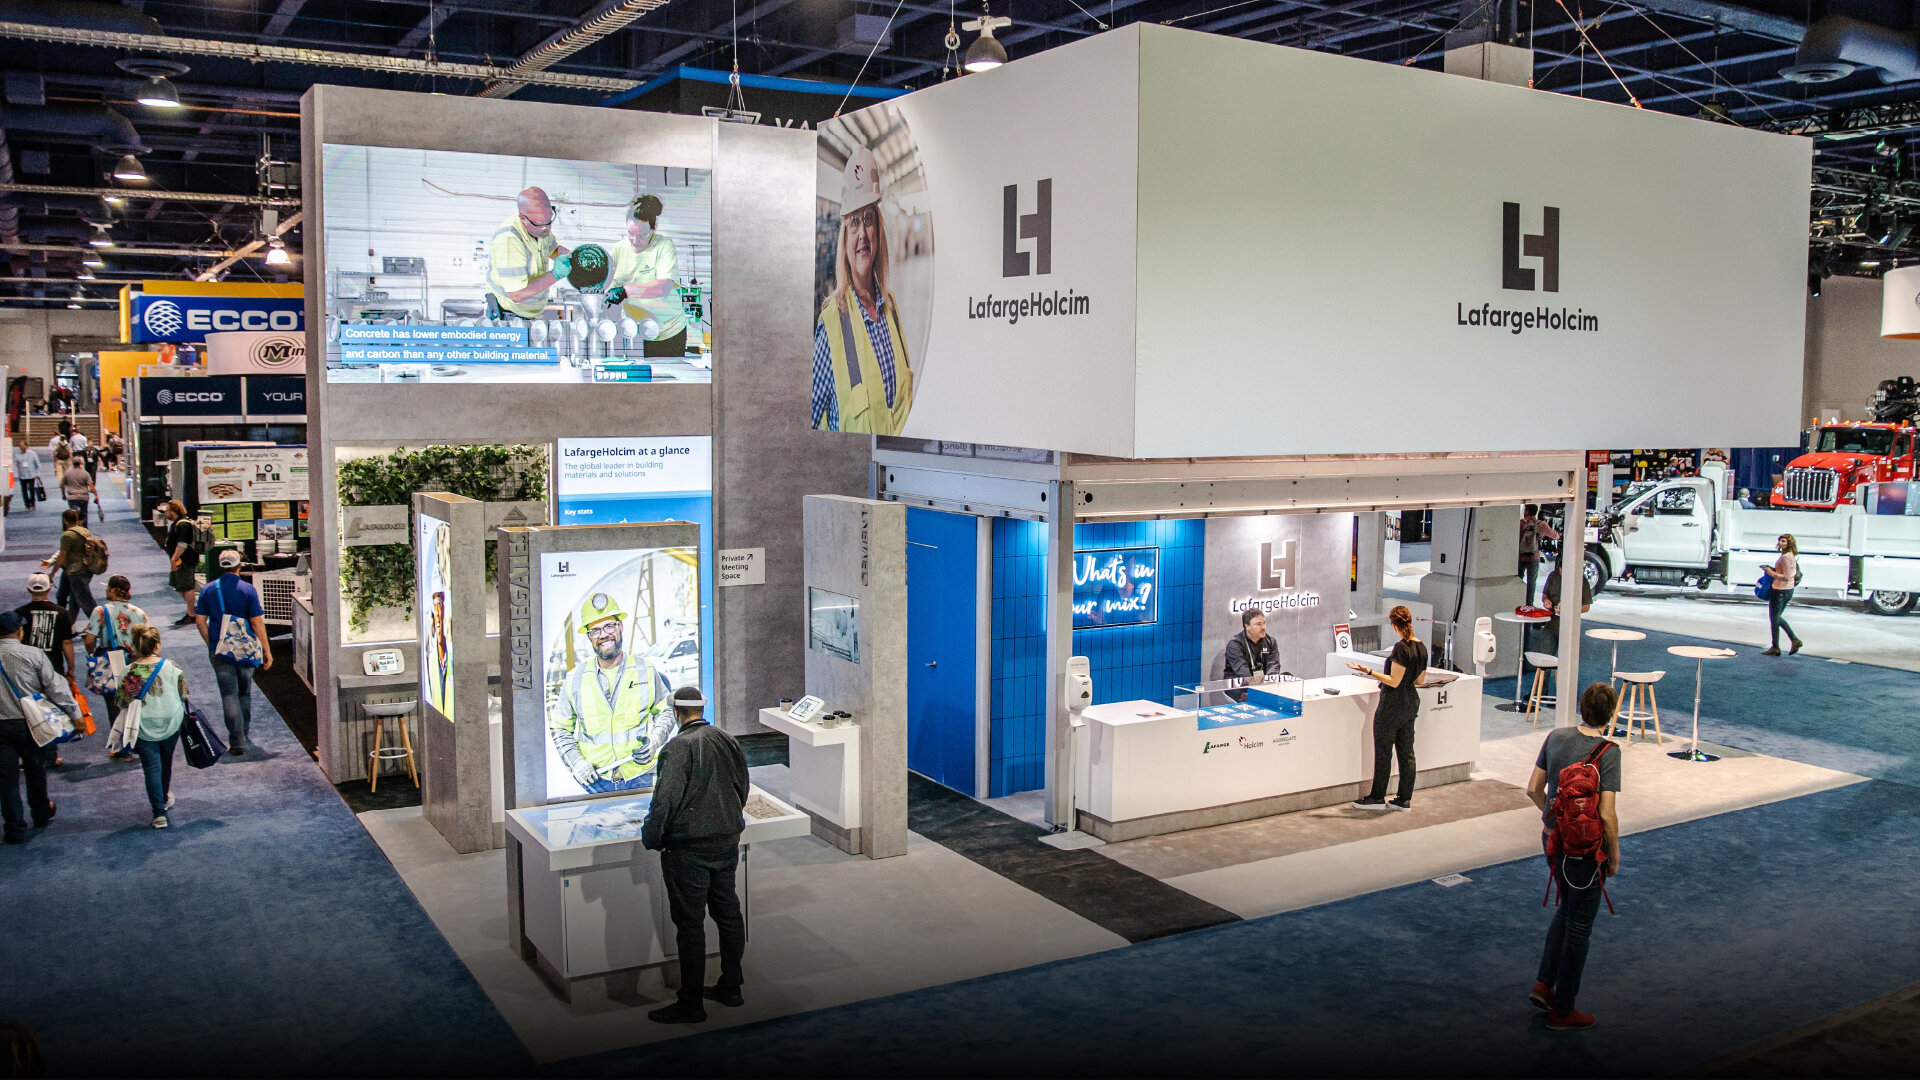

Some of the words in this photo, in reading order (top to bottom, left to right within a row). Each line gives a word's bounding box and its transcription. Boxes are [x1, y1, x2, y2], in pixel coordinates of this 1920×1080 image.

[968, 288, 1090, 325] LafargeHolcim
[186, 309, 298, 331] ECCO
[1457, 302, 1599, 335] LafargeHolcim
[345, 328, 391, 340] Concrete
[392, 329, 411, 340] has
[412, 330, 440, 341] lower
[441, 330, 487, 341] embodied
[489, 331, 521, 342] energy
[345, 349, 366, 360] and
[367, 350, 401, 360] carbon
[403, 350, 425, 360] than
[426, 351, 445, 362] any
[447, 351, 471, 361] other
[473, 351, 510, 363] building
[511, 352, 551, 362] material.
[174, 392, 223, 402] ECCO
[263, 392, 303, 401] YOUR
[564, 446, 636, 459] LafargeHolcim
[638, 447, 649, 456] at
[659, 446, 690, 457] glance
[579, 463, 602, 472] global
[635, 461, 664, 470] building
[564, 471, 598, 479] materials
[614, 470, 646, 478] solutions
[564, 508, 577, 516] Key
[1134, 564, 1155, 578] in
[1105, 582, 1152, 613] mix?
